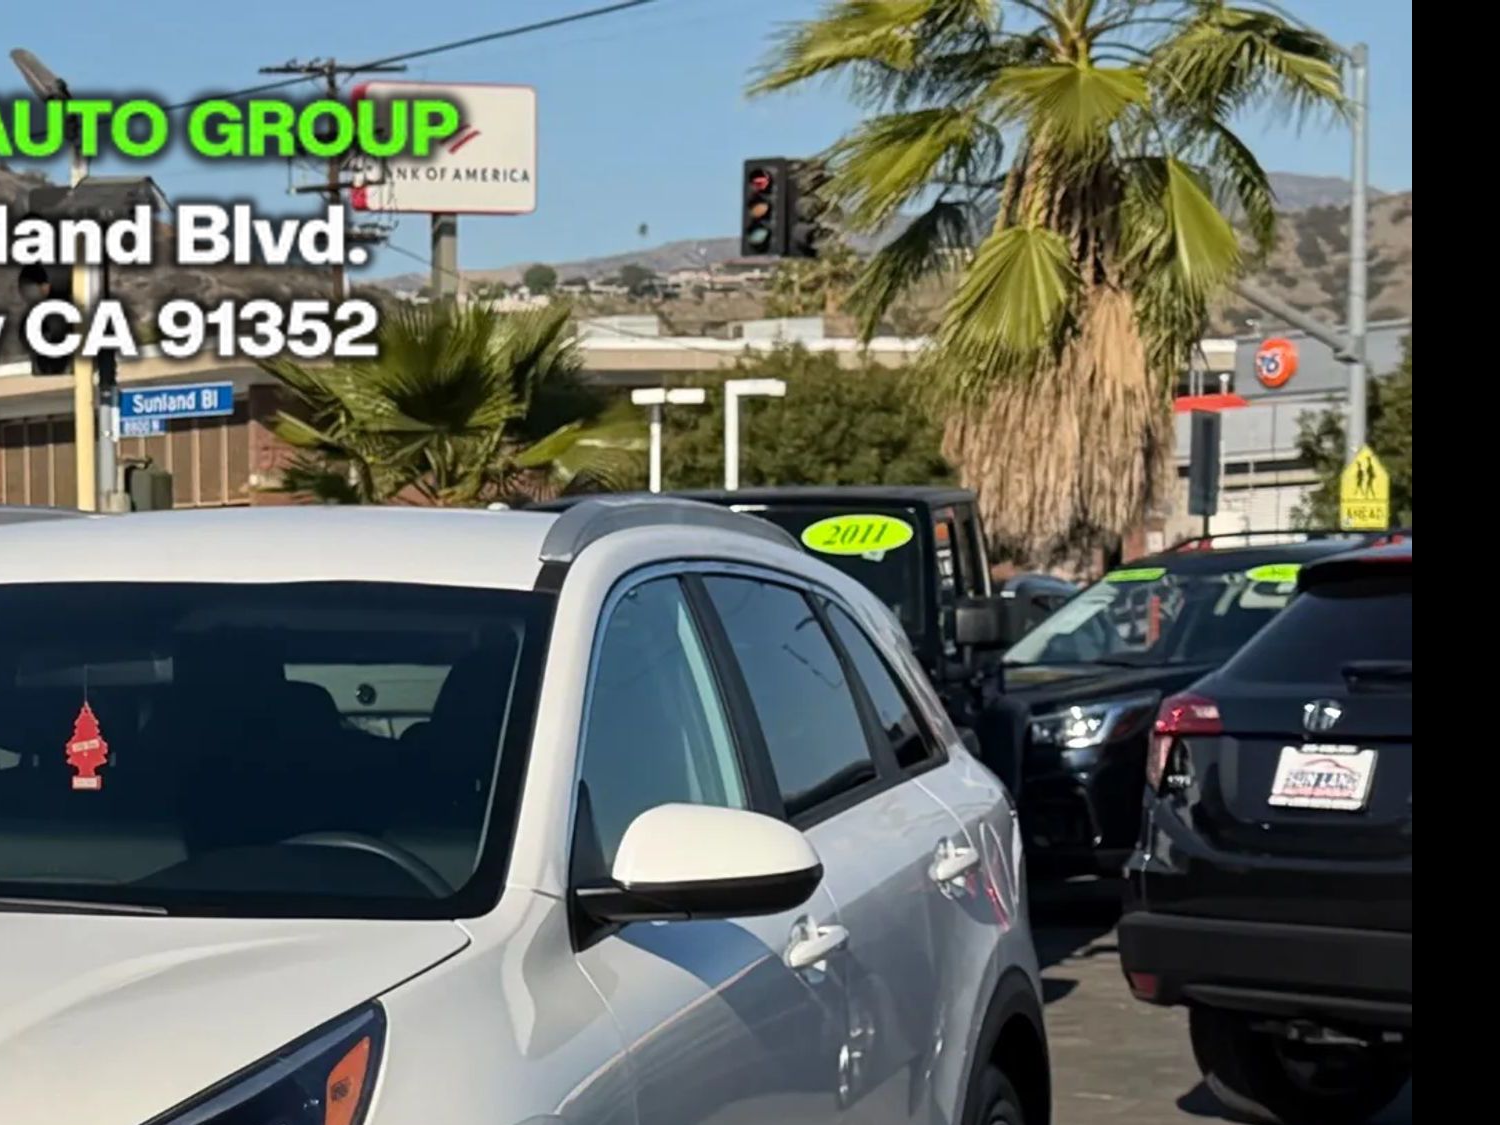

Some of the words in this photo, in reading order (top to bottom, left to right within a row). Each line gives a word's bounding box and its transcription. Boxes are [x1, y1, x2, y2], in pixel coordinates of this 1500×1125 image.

[426, 167, 448, 181] OF
[452, 168, 531, 183] AMERICA
[132, 391, 197, 414] Sunland
[201, 388, 218, 409] Bl
[822, 522, 889, 546] 2011
